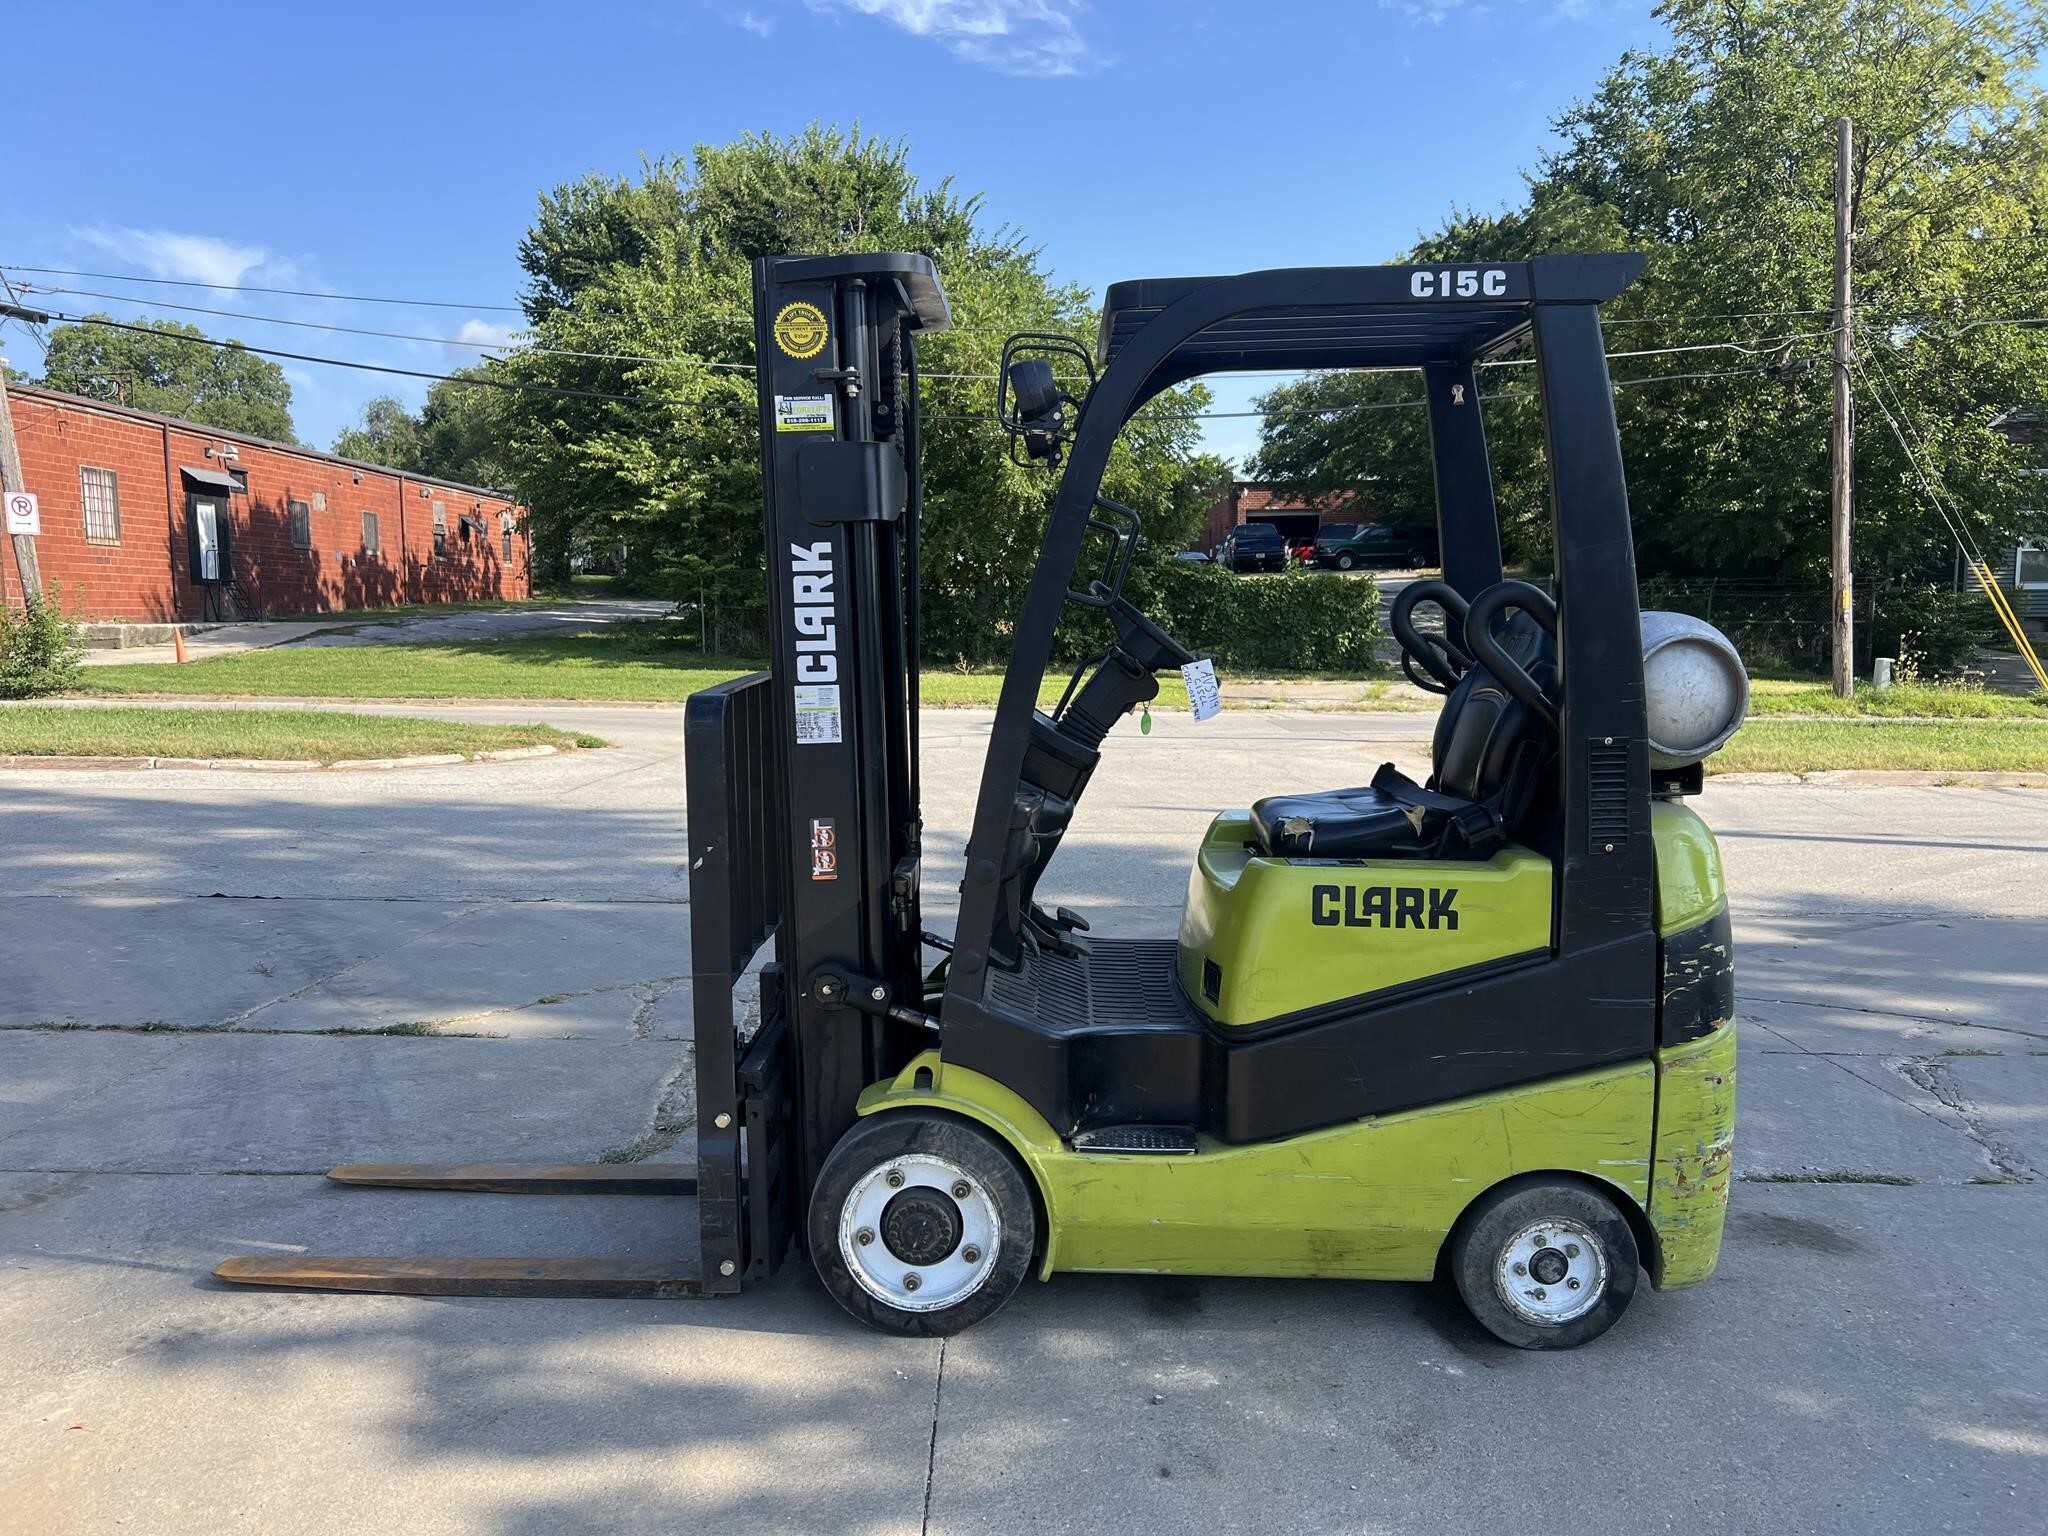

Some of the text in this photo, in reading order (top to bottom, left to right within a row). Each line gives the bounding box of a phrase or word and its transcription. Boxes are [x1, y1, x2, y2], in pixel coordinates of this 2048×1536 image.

[1411, 270, 1506, 297] C15C
[791, 542, 837, 682] CLARK
[1312, 885, 1459, 930] CLARK
